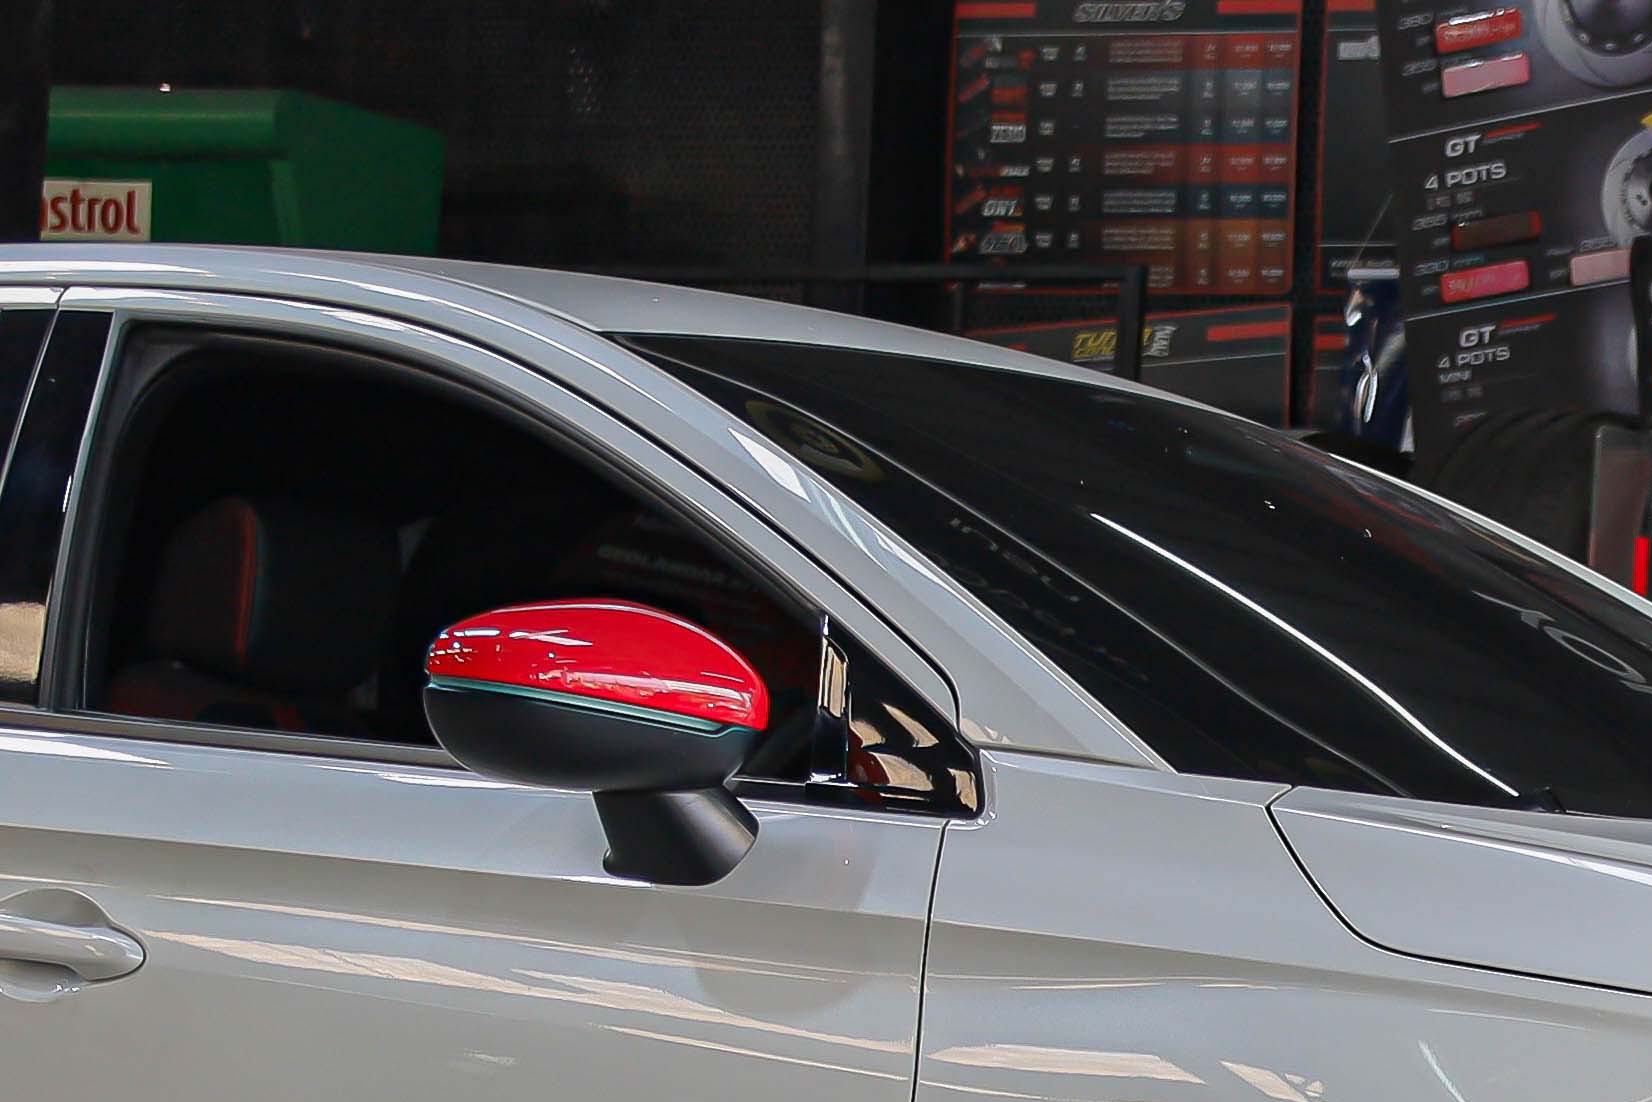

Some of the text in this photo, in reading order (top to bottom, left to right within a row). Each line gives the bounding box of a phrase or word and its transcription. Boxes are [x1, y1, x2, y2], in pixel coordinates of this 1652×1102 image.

[1446, 134, 1482, 157] GT
[1424, 162, 1507, 190] 4 POTS
[1460, 324, 1496, 347] GT
[1438, 346, 1511, 369] 4 POTS
